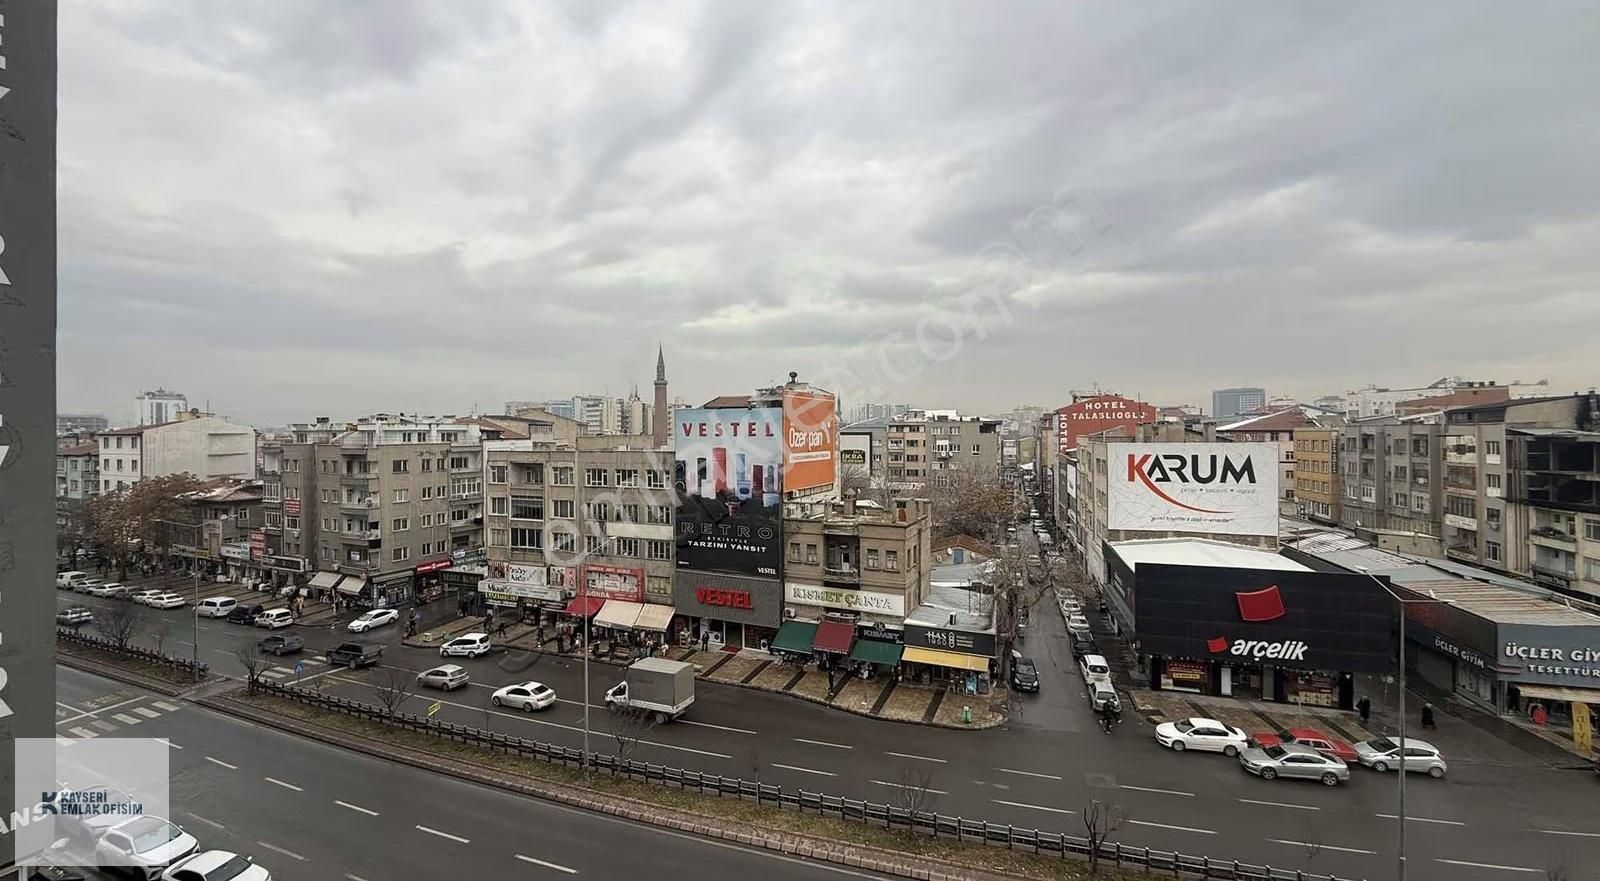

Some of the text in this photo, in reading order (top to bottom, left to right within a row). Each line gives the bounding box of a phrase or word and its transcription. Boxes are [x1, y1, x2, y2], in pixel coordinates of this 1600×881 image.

[1085, 401, 1126, 410] HOTEL
[682, 422, 774, 437] VESTEL
[1059, 414, 1068, 451] HOTEL
[1127, 453, 1257, 484] KARUM
[680, 521, 774, 540] RETRO
[687, 540, 767, 553] TARZINI YANSIT
[695, 587, 753, 610] VESTEL
[1230, 638, 1309, 662] arçelik
[1505, 642, 1563, 661] ÜÇLER
[1528, 664, 1600, 677] TESETTÜR
